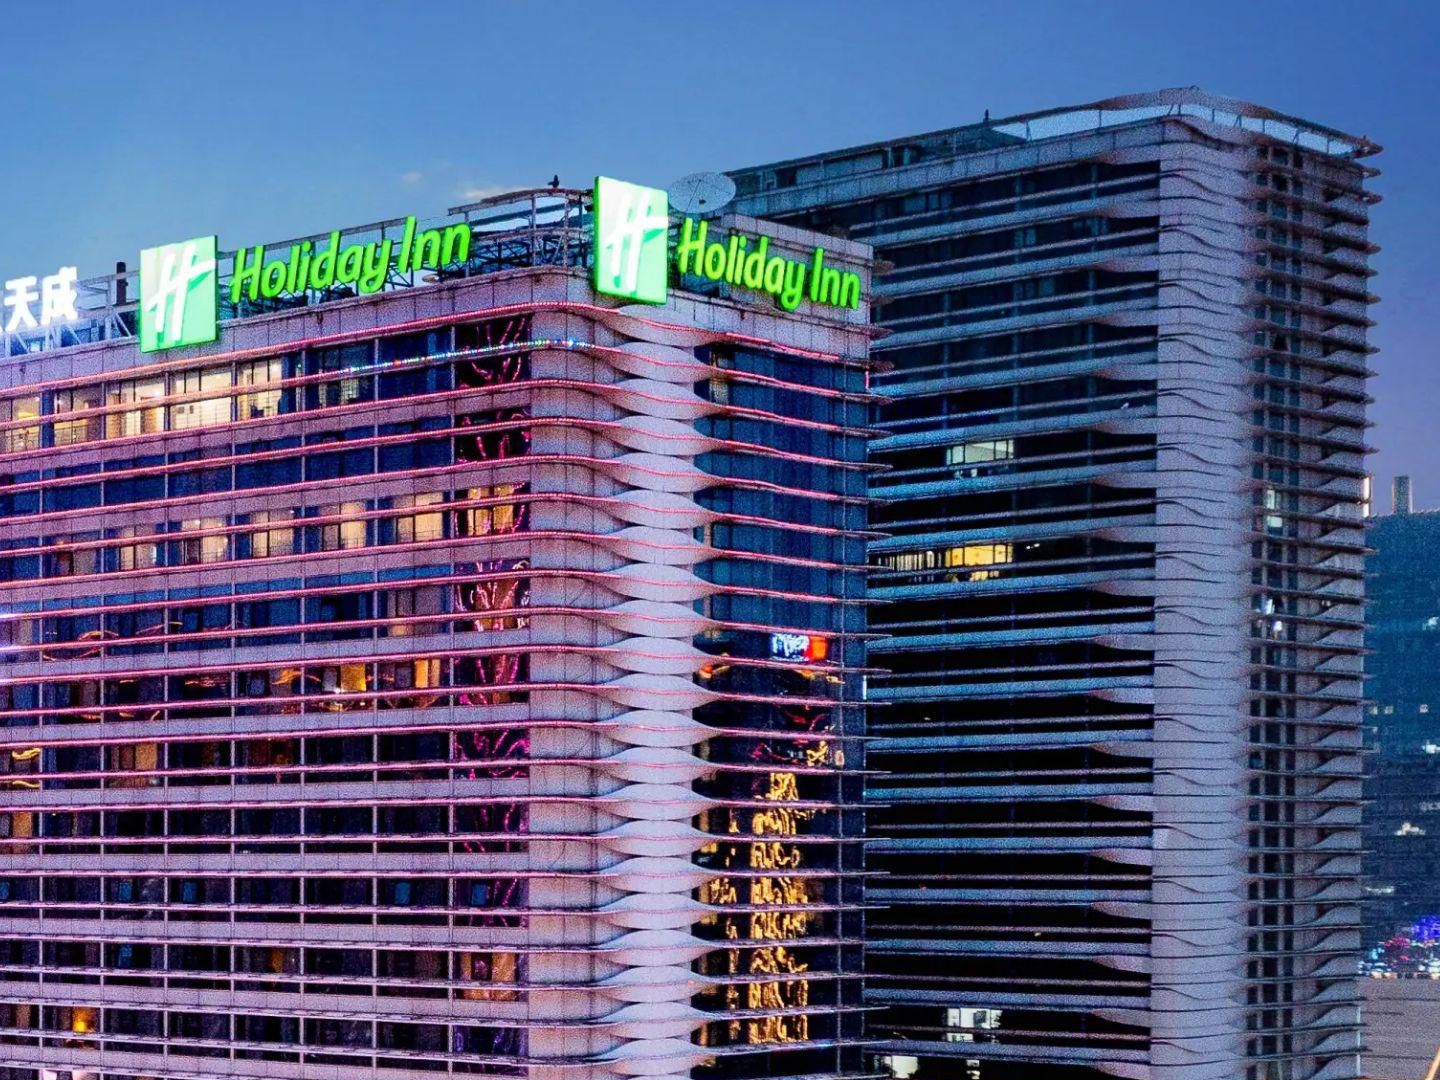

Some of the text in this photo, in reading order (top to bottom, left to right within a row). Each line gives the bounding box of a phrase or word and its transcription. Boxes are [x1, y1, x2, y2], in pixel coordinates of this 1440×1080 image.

[231, 216, 471, 304] Holiday Inn
[677, 217, 862, 312] Holiday Inn
